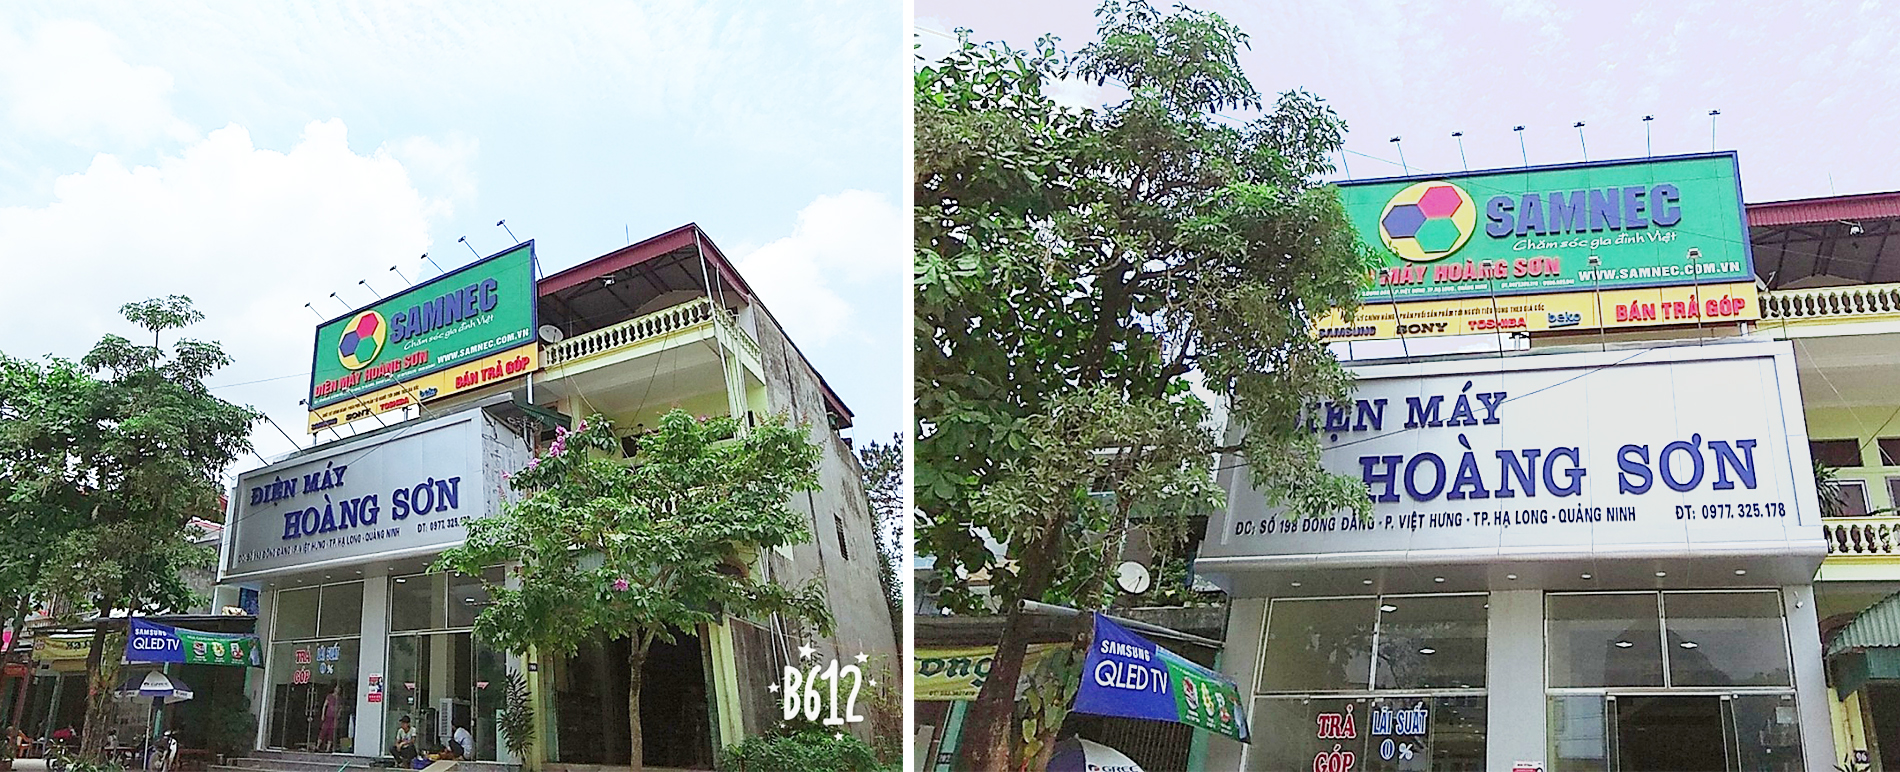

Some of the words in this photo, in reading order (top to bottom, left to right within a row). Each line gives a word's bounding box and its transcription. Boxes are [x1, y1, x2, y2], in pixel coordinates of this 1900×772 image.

[1486, 184, 1681, 239] SAMNEC
[1513, 239, 1558, 250] Chăm
[1559, 236, 1588, 247] sóc
[1590, 237, 1612, 249] gia
[1615, 232, 1645, 245] đình
[1647, 230, 1677, 243] Việt
[1434, 259, 1508, 283] HOÀNG
[1513, 256, 1562, 279] SƠN
[1578, 261, 1740, 281] WWW.SAMNEC.COM.VN
[390, 277, 498, 344] SAMNEC
[1396, 322, 1447, 335] SONY
[1468, 317, 1527, 331] TOSHIBA
[1547, 312, 1581, 324] beko
[1615, 300, 1656, 322] BÁN
[1661, 295, 1700, 320] TRẢ
[1705, 295, 1746, 317] GÓP
[437, 328, 530, 363] WWW.SAMNEC.COM.VN
[455, 371, 479, 389] BÁN
[481, 360, 504, 381] TRẢ
[505, 355, 530, 373] GÓP
[1404, 380, 1507, 429] MÁY
[250, 475, 298, 506] ĐIỆN
[303, 460, 348, 494] MÁY
[1359, 433, 1587, 503] HOÀNG
[1617, 433, 1757, 495] SƠN
[282, 494, 380, 540] HOÀNG
[392, 477, 461, 521] SƠN
[1259, 513, 1278, 534] SỐ
[1400, 510, 1425, 532] VIỆT
[1429, 512, 1462, 528] HƯNG
[1474, 511, 1490, 526] TP.
[1494, 510, 1511, 528] HẠ
[1515, 509, 1548, 525] LONG
[1558, 503, 1601, 523] QUẢNG
[1606, 506, 1636, 522] NINH
[1675, 504, 1696, 520] ĐT:
[133, 637, 165, 650] QLED
[165, 638, 180, 650] TV
[134, 628, 167, 636] SAMSUNG
[295, 644, 312, 664] TRẢ
[1101, 640, 1150, 662] SAMSUNG
[1095, 660, 1149, 690] QLED
[1150, 668, 1168, 694] TV
[1317, 703, 1356, 738] TRẢ
[1372, 706, 1393, 735] LÃI
[1395, 701, 1428, 735] SUẤT
[1314, 743, 1355, 772] GÓP
[1380, 738, 1395, 760] 0
[1399, 742, 1413, 760] %
